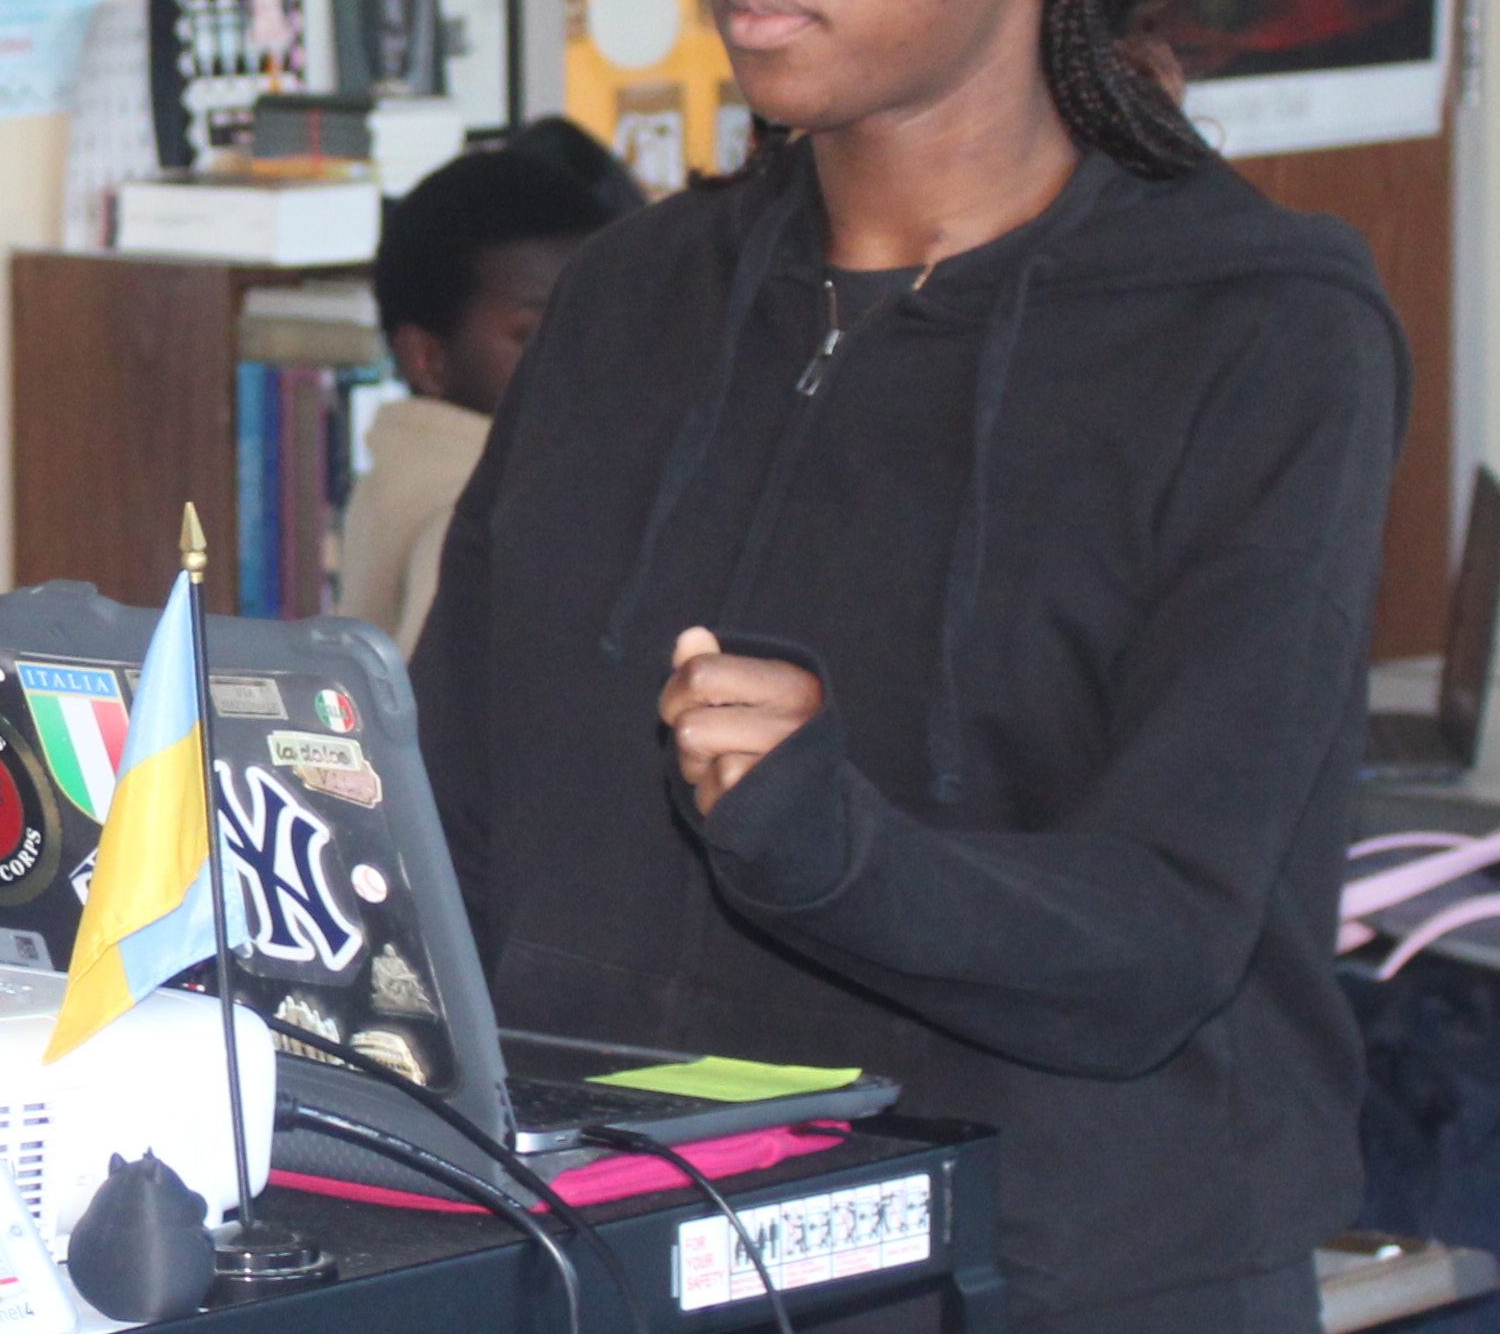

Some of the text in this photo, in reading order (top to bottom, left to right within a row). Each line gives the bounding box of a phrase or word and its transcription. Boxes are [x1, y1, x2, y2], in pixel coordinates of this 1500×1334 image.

[26, 668, 110, 693] ITALIA
[685, 1234, 707, 1252] FOR
[685, 1252, 715, 1272] YOUR
[686, 1271, 725, 1292] SAFETY
